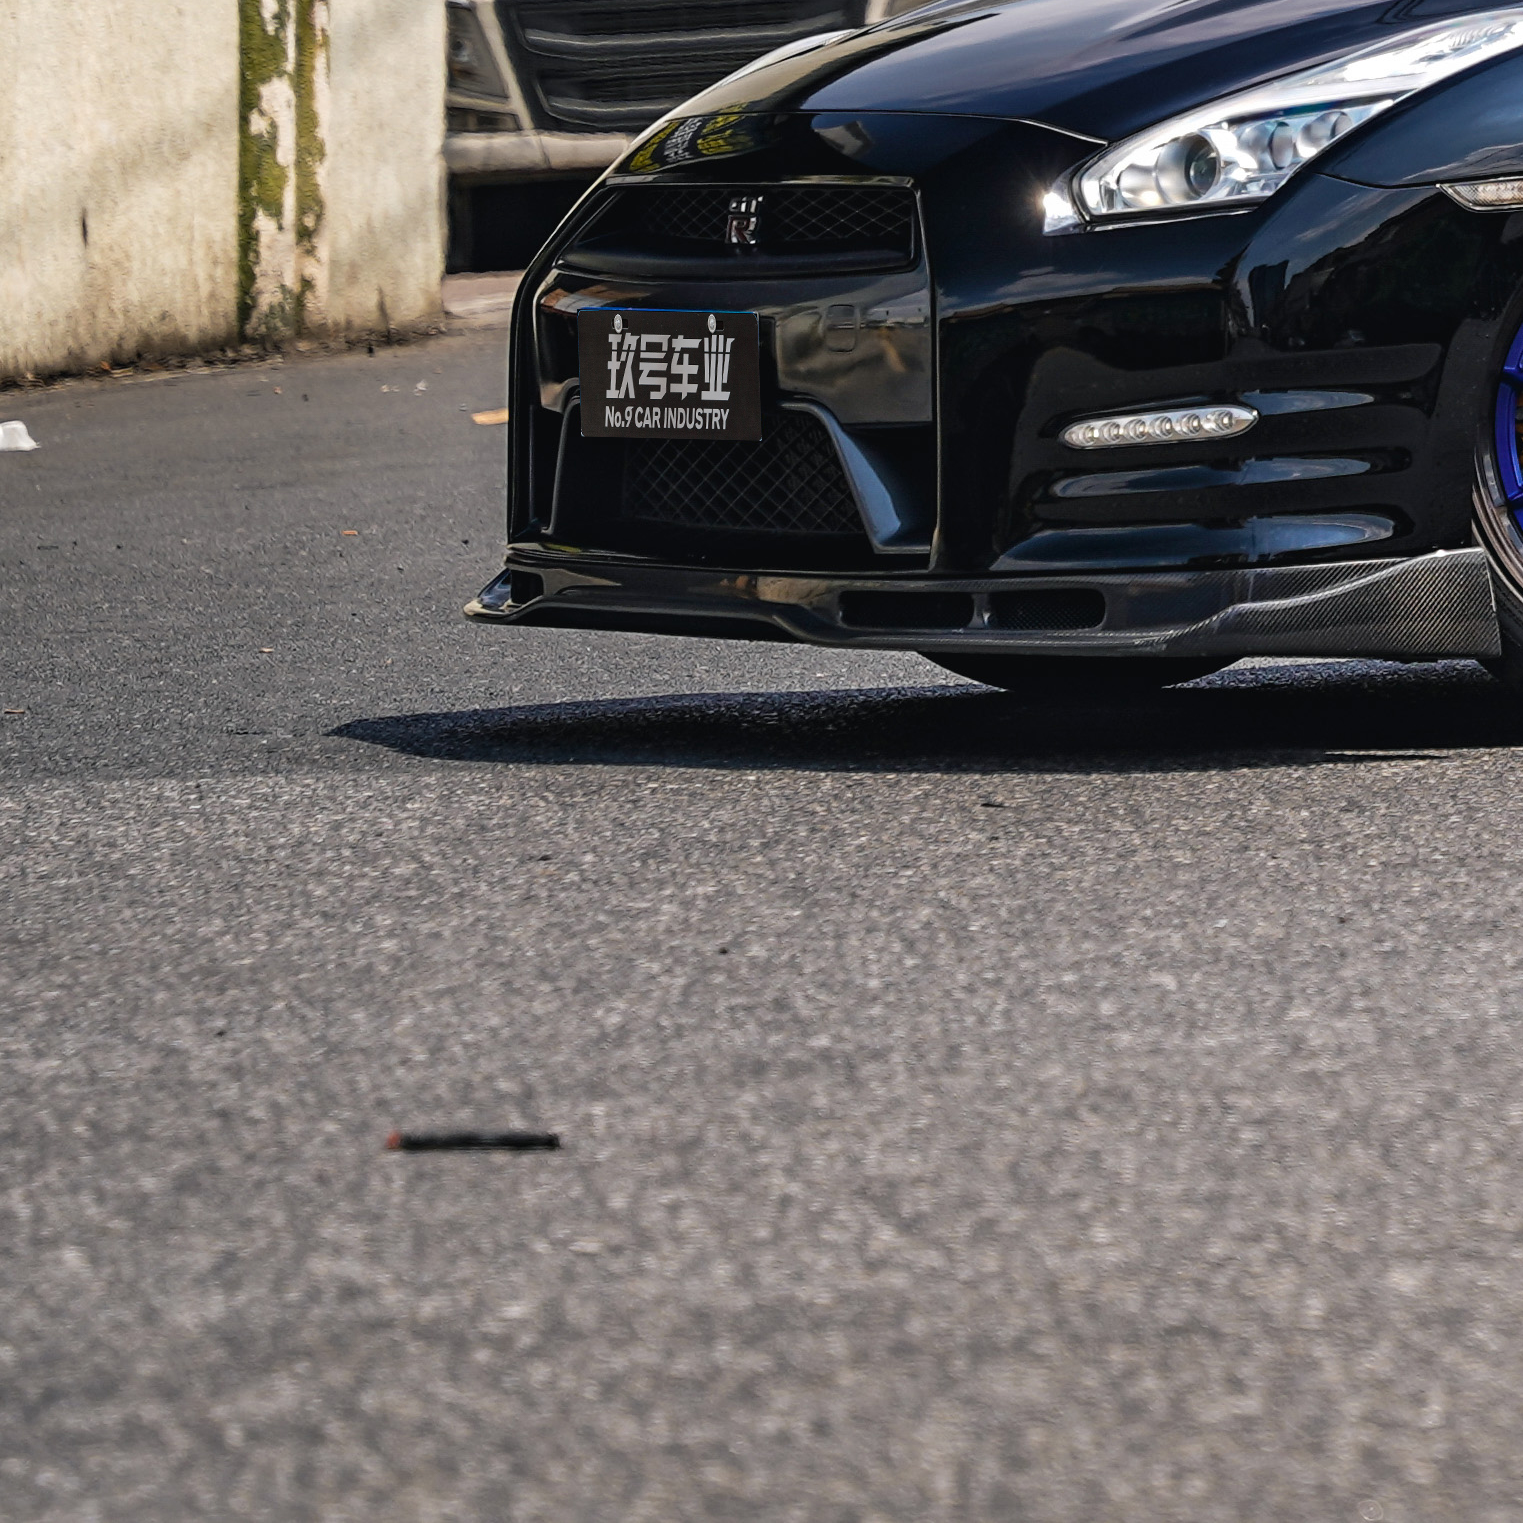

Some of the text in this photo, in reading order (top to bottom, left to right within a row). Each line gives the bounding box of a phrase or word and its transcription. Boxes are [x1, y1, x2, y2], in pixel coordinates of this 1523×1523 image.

[606, 332, 735, 401] 玖号车业
[604, 405, 730, 430] No.9 CAR INDUSTRY
